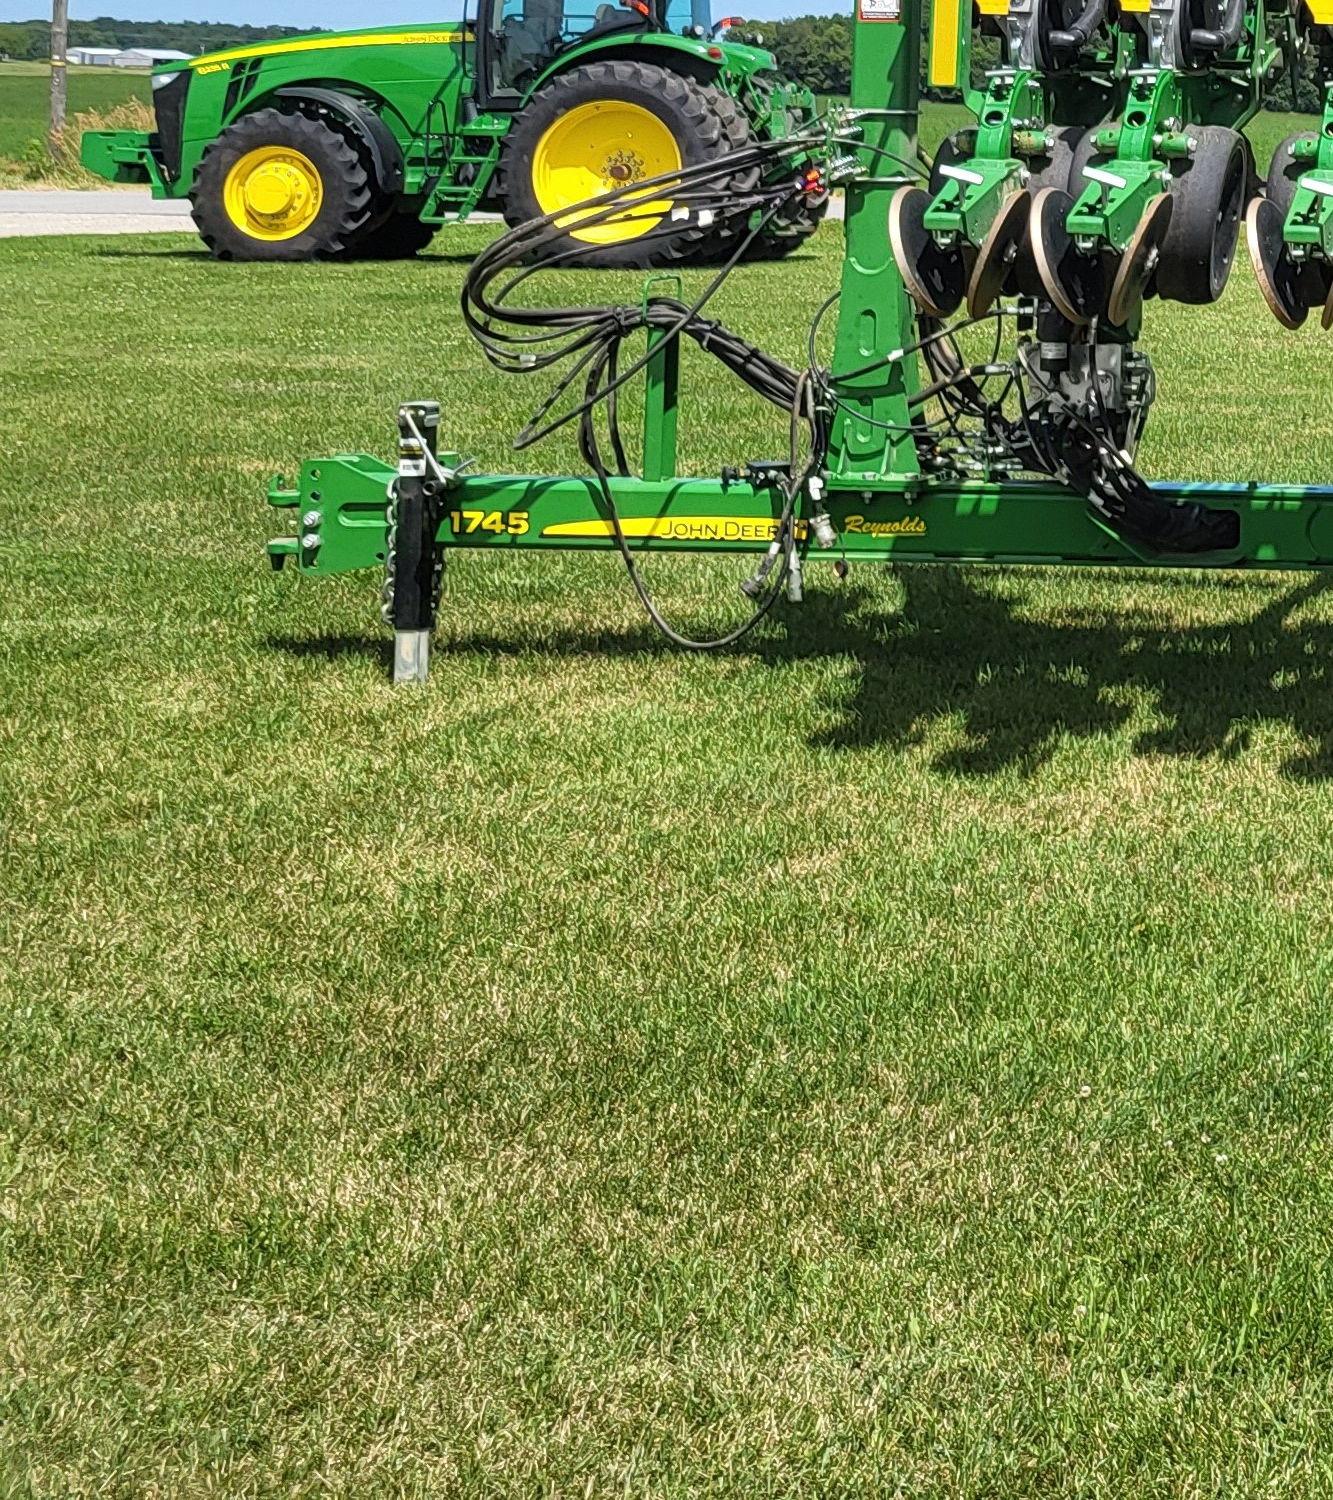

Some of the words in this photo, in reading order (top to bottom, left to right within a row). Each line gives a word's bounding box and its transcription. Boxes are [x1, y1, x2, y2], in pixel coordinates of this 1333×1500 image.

[450, 510, 530, 535] 1745
[661, 520, 718, 537] JOHN
[724, 521, 791, 538] DEER
[844, 514, 927, 538] Reynolds
